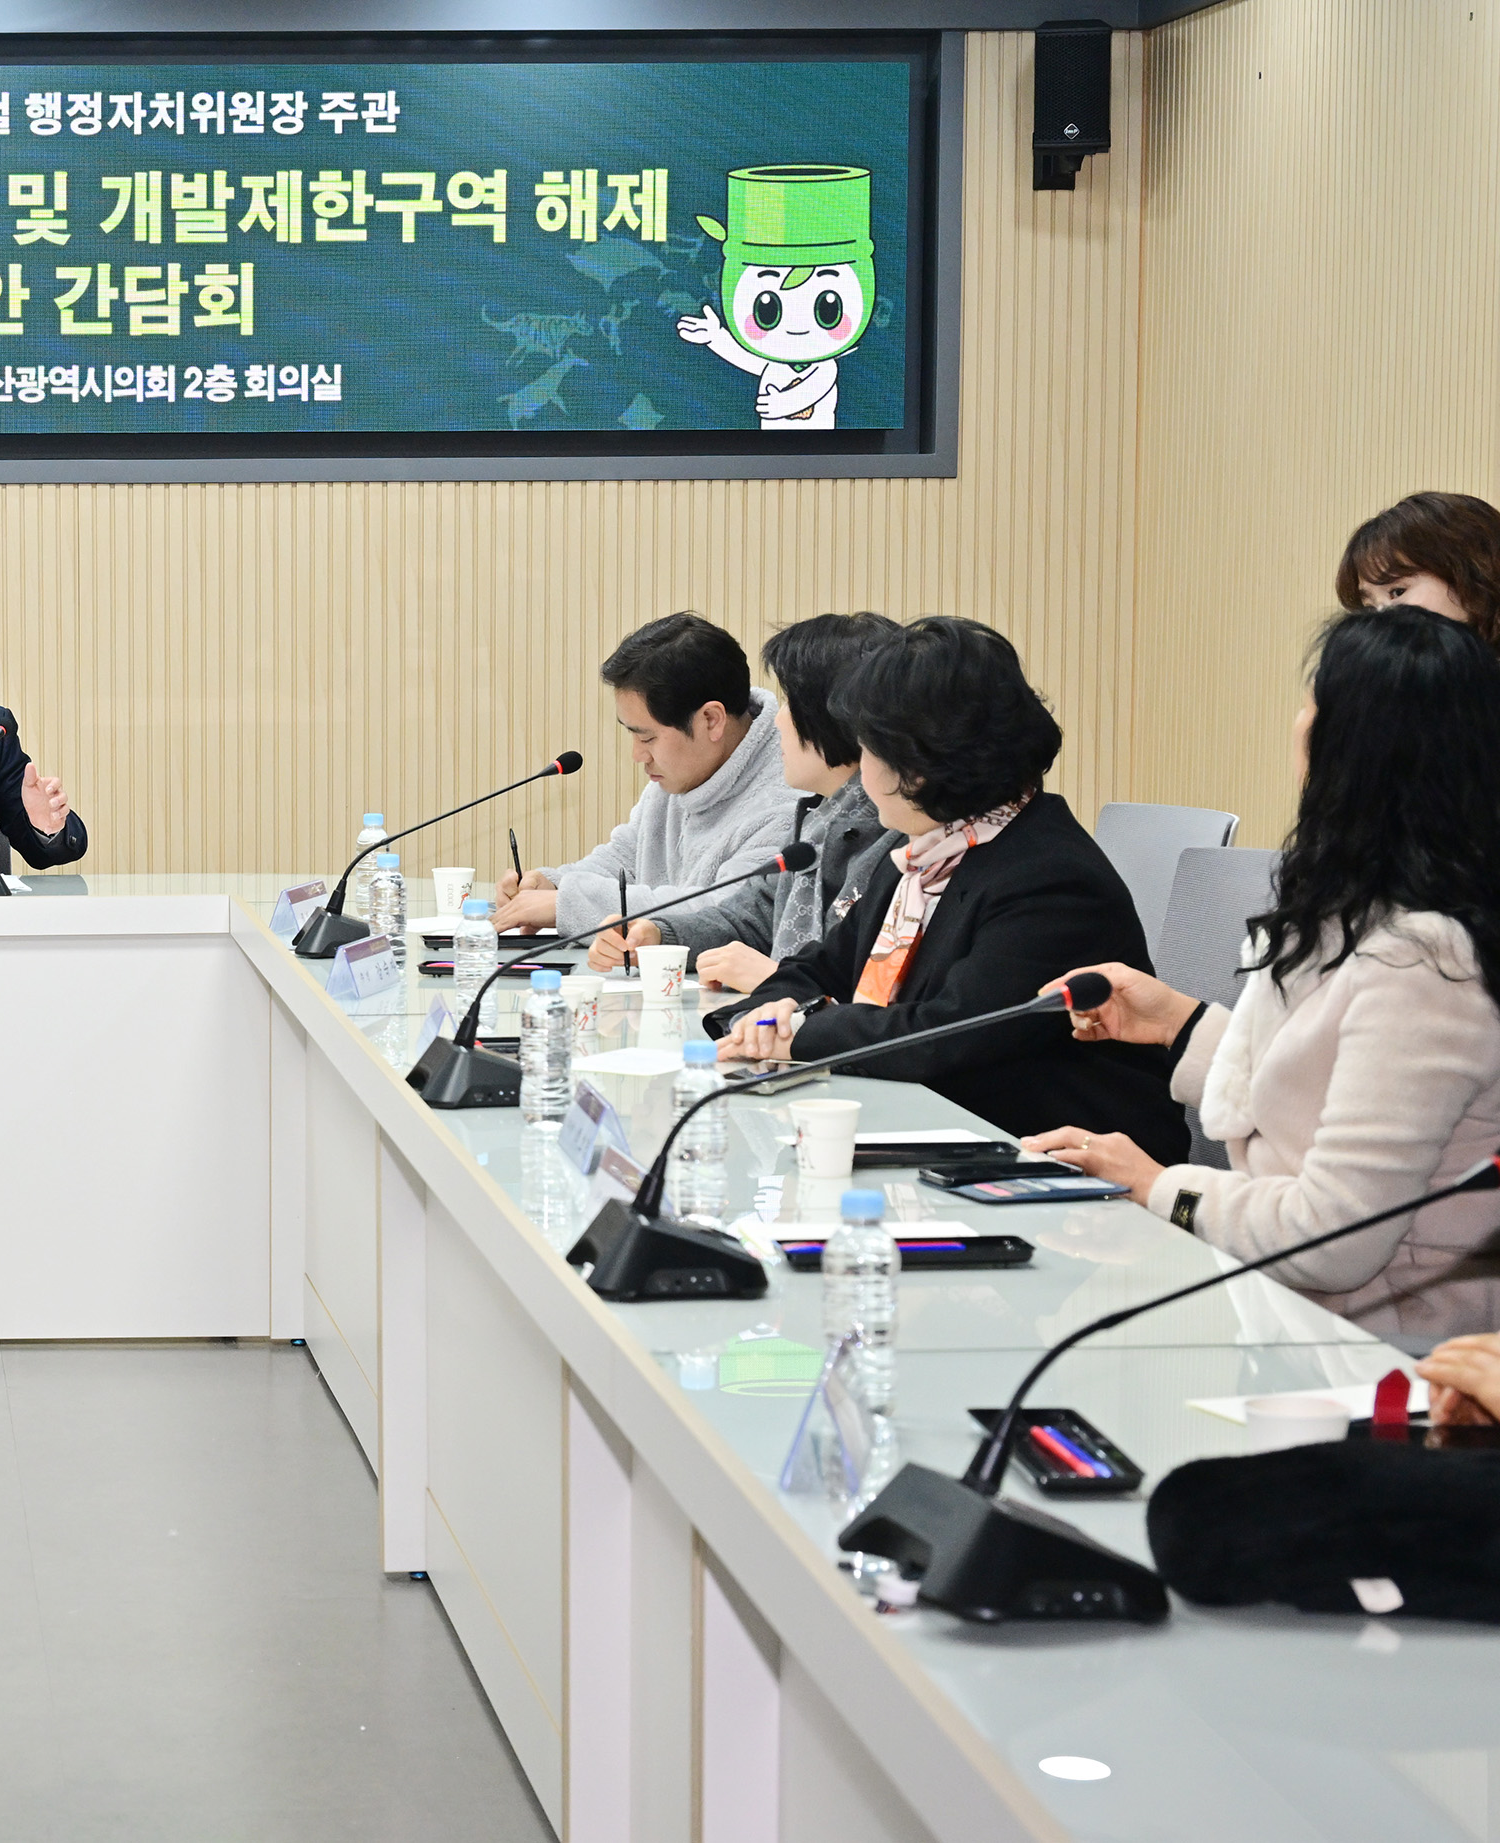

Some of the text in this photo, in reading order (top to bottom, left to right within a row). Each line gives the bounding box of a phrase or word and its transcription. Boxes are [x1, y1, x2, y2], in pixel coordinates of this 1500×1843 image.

[24, 90, 310, 137] 행정자치위원장
[318, 90, 402, 136] 주관
[8, 170, 73, 247] 및
[99, 168, 510, 246] 개발제한구역
[534, 168, 671, 245] 해제
[53, 262, 257, 338] 간담회
[183, 364, 239, 404] 2층
[244, 363, 344, 403] 회의실
